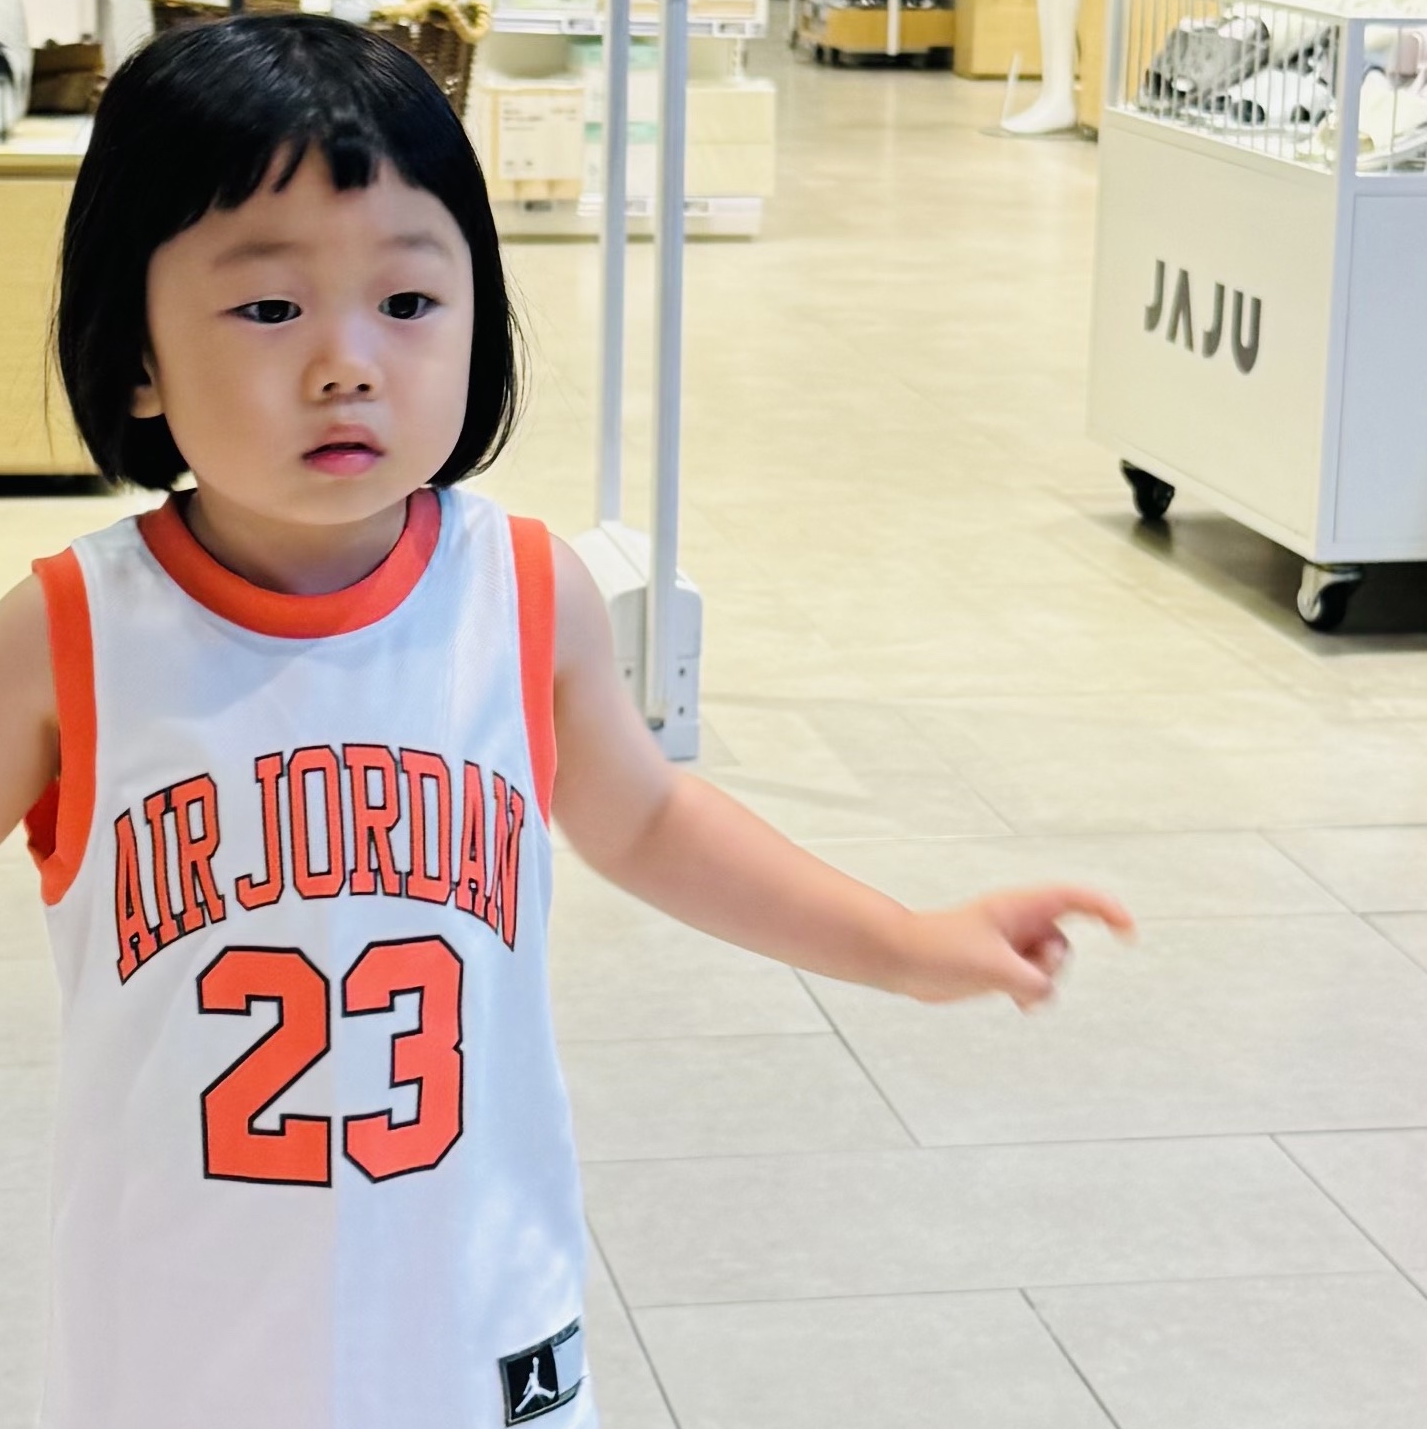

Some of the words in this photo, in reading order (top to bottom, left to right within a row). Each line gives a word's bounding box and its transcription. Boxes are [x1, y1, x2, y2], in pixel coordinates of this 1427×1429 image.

[1143, 259, 1262, 376] JAJU
[114, 773, 227, 984] AIR
[235, 743, 525, 951] JORDAN
[197, 935, 464, 1188] 23
